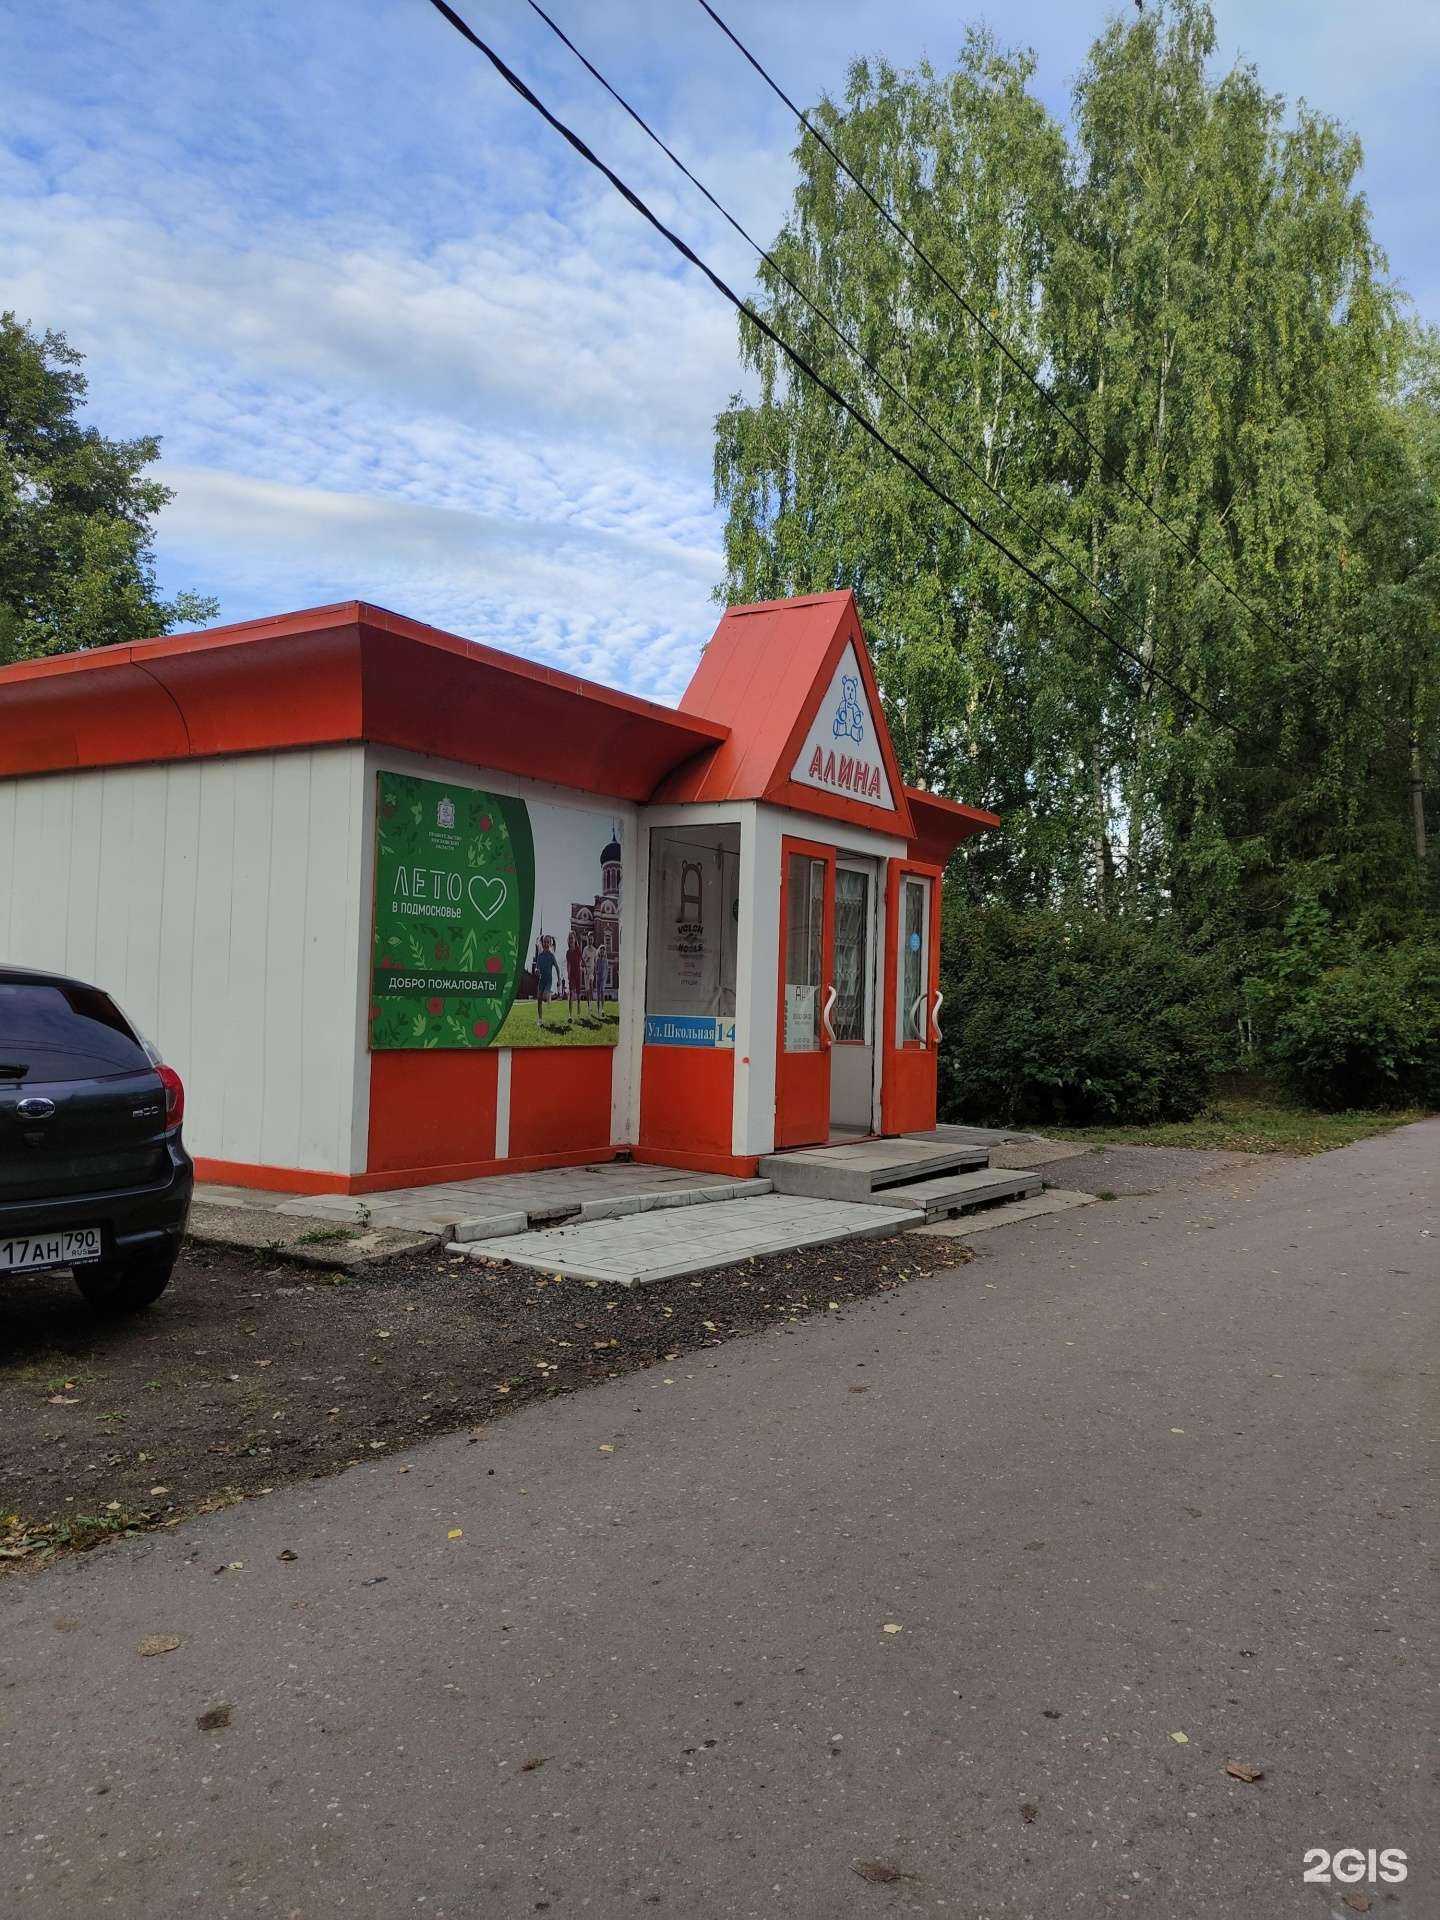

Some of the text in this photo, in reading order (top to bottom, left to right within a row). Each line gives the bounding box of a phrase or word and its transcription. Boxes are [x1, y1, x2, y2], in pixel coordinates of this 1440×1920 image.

[808, 745, 881, 800] АЛИНА
[393, 865, 463, 901] ЛЕТО
[392, 901, 462, 919] В ПОДМОСКОВЬЕ
[388, 977, 497, 991] ДОБРО ПОЖАЛОВАТЬ!
[648, 1022, 715, 1040] Ул. Школьная
[717, 1024, 736, 1042] 14
[64, 1231, 96, 1249] 790
[71, 1248, 88, 1256] RUS
